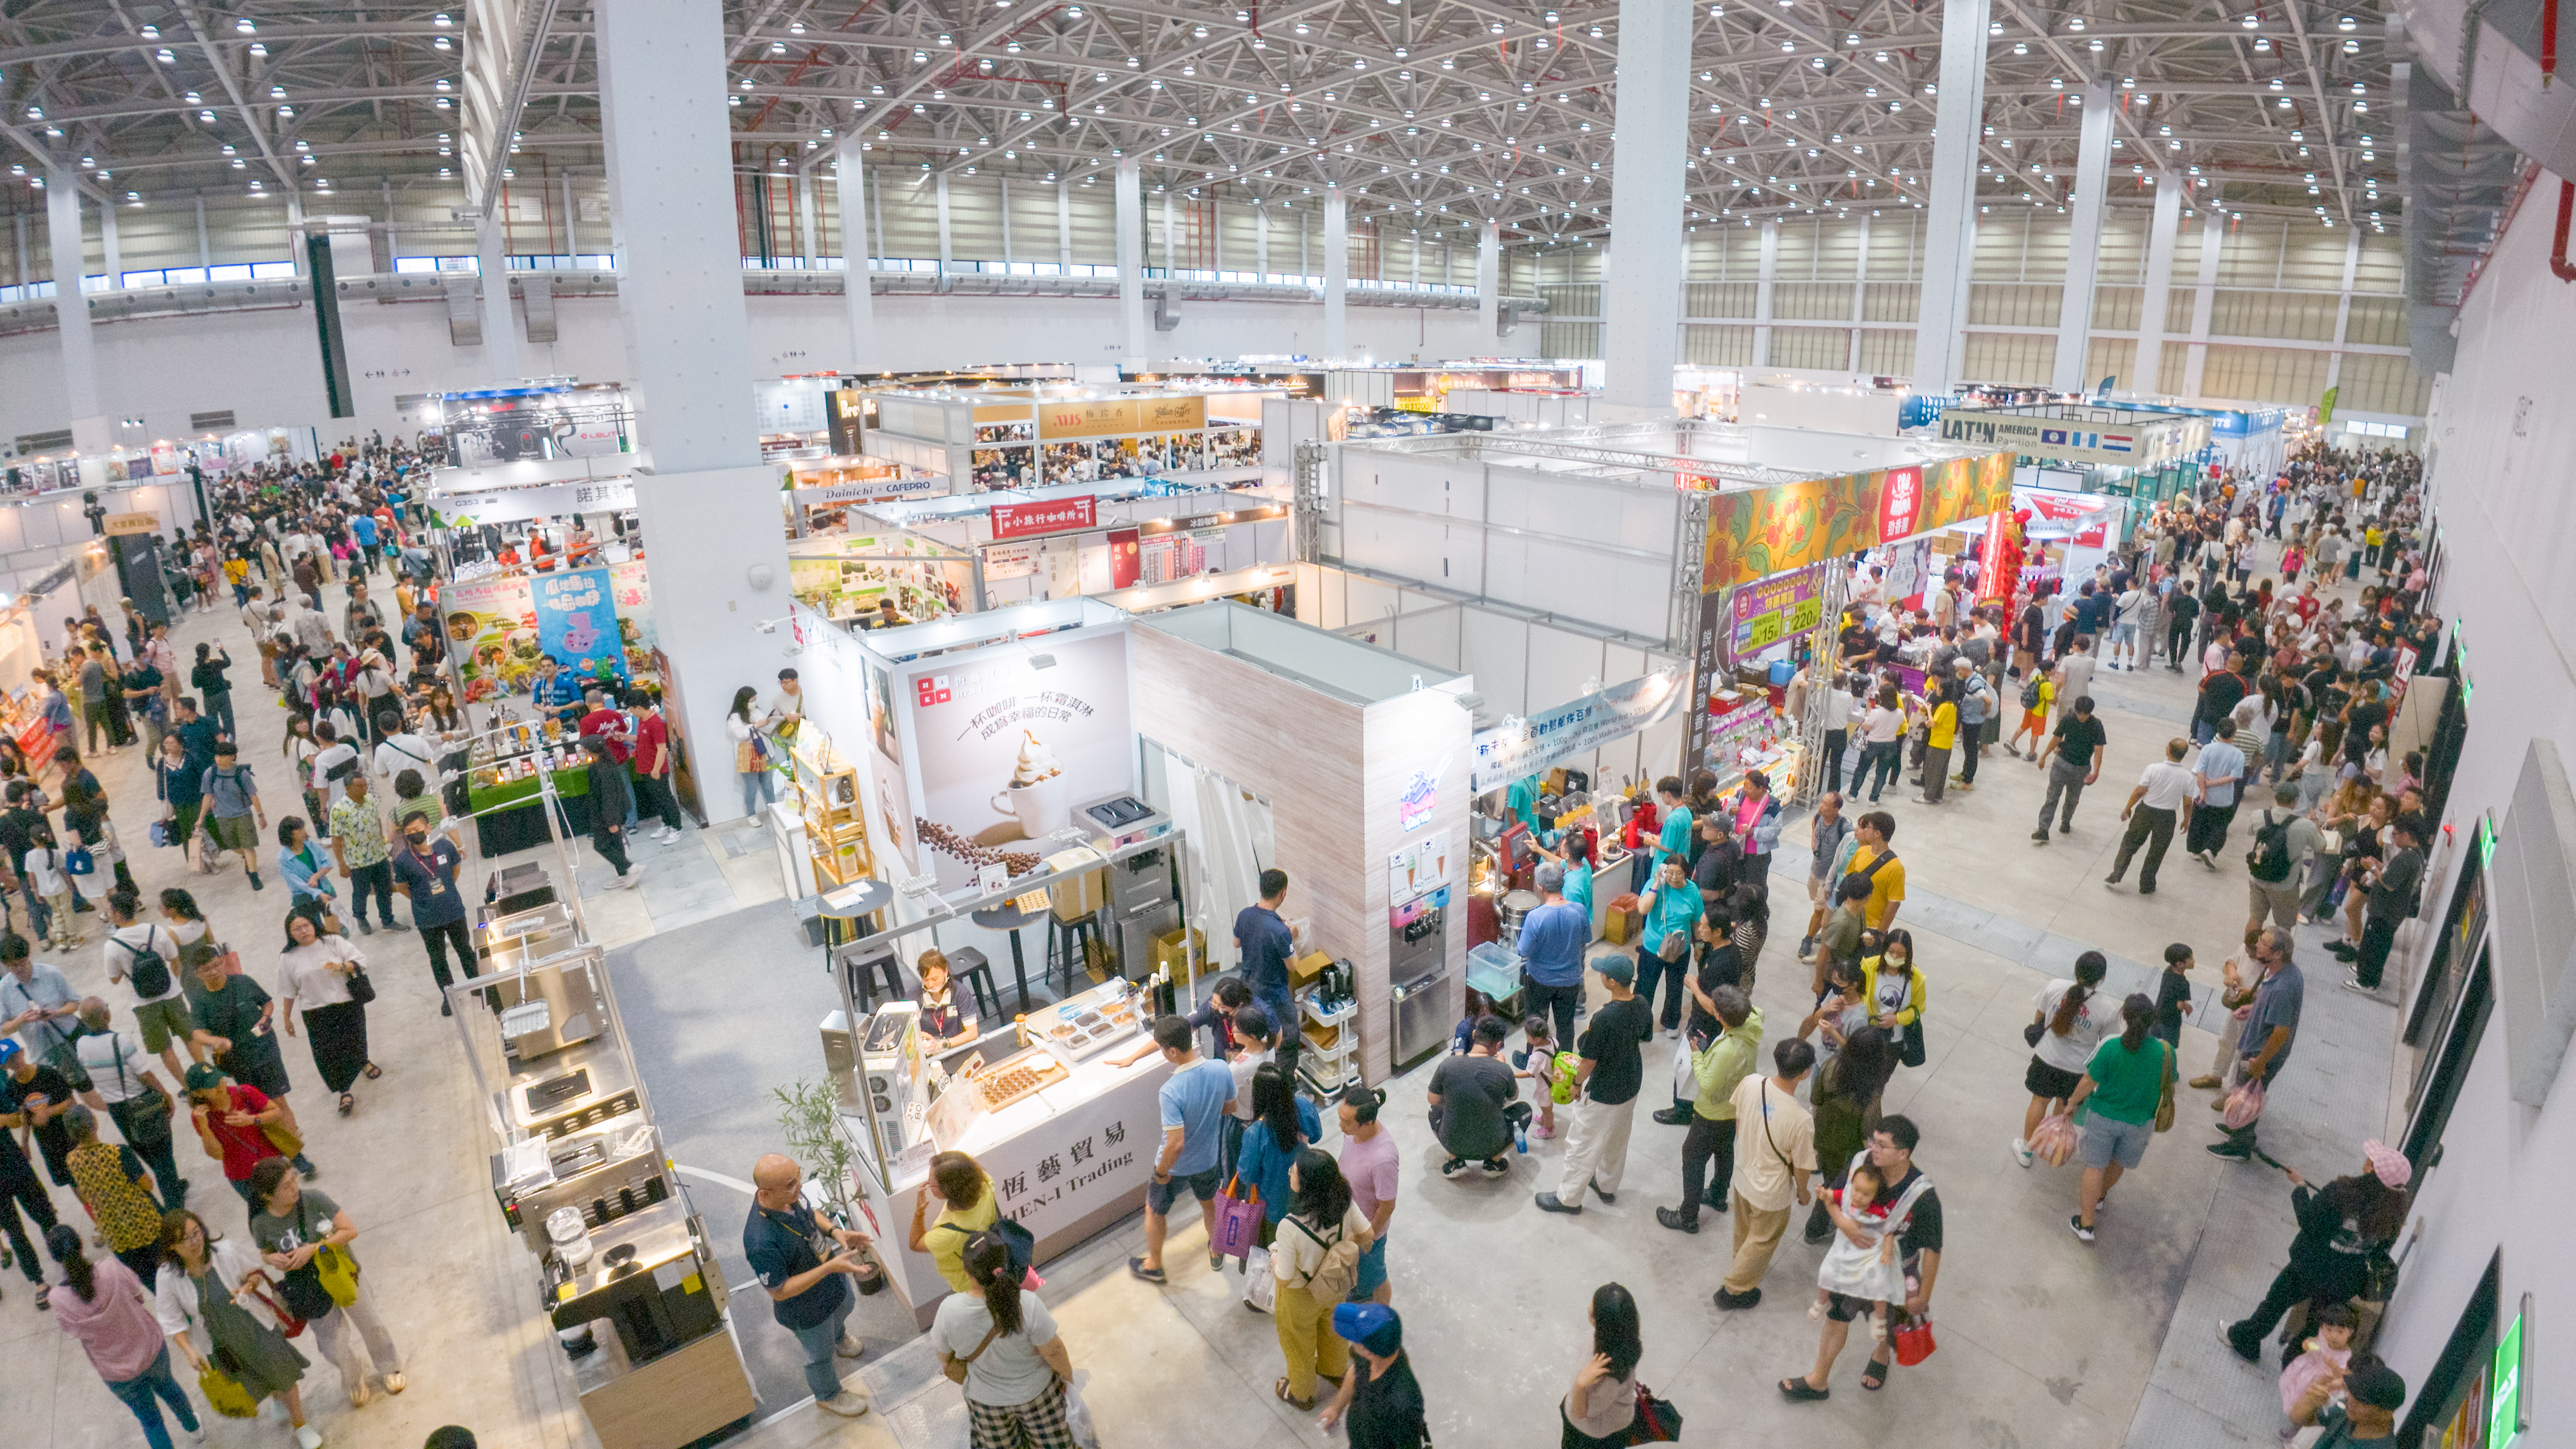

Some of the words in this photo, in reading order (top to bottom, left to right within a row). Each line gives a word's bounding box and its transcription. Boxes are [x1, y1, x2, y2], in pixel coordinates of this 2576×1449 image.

[1942, 419, 1996, 443] LATIN
[1998, 424, 2038, 436] AMERICA
[1997, 436, 2037, 449] Pavilion
[826, 487, 873, 498] Dainichi
[886, 481, 930, 492] CAFEPRO
[1012, 510, 1076, 527] 小旅行咖啡所
[1765, 589, 1796, 611] 特惠專區
[957, 696, 1017, 741] 一杯咖啡
[1024, 691, 1094, 718] 一杯霜淇淋
[1600, 716, 1617, 726] World
[1618, 713, 1628, 721] first
[1634, 705, 1646, 716] 100g
[1599, 729, 1614, 738] Made
[1002, 1121, 1125, 1201] 恆藝貿易
[1003, 1187, 1061, 1222] HEN-I
[1066, 1151, 1133, 1192] Trading
